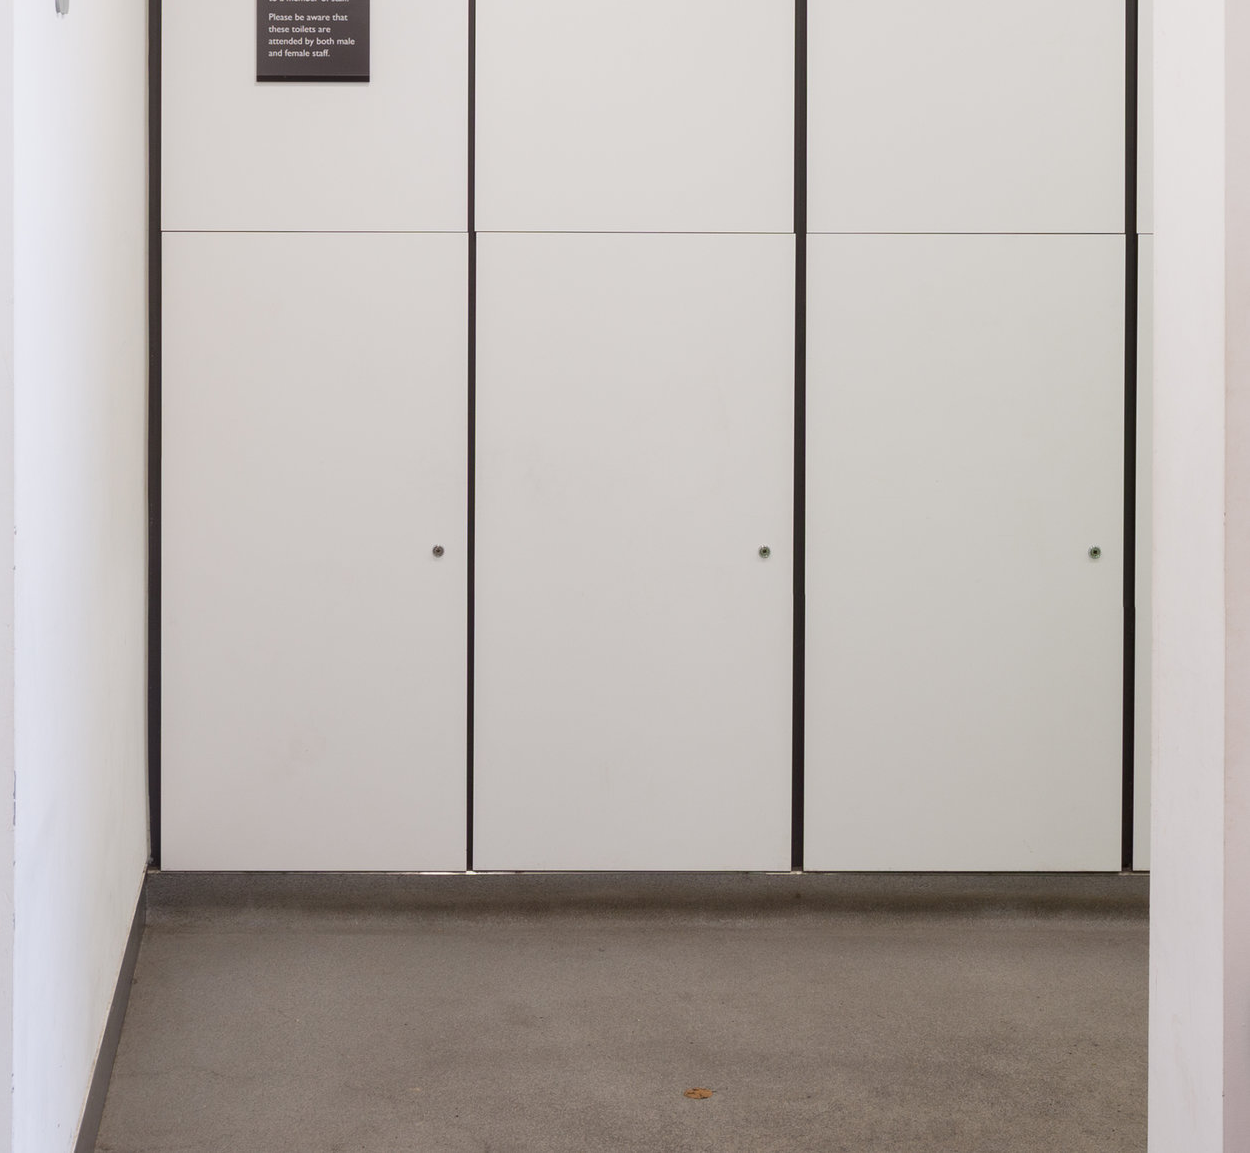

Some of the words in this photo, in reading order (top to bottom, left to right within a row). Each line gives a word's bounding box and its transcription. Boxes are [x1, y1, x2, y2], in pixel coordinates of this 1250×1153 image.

[268, 12, 293, 21] Please
[294, 13, 305, 21] be
[332, 13, 348, 22] that
[268, 25, 290, 33] these
[291, 25, 316, 33] toilets
[268, 37, 303, 45] attended
[304, 37, 315, 47] by
[316, 37, 335, 45] both
[336, 37, 355, 46] male
[268, 49, 283, 57] and
[284, 48, 310, 57] female
[312, 48, 330, 57] staff.
